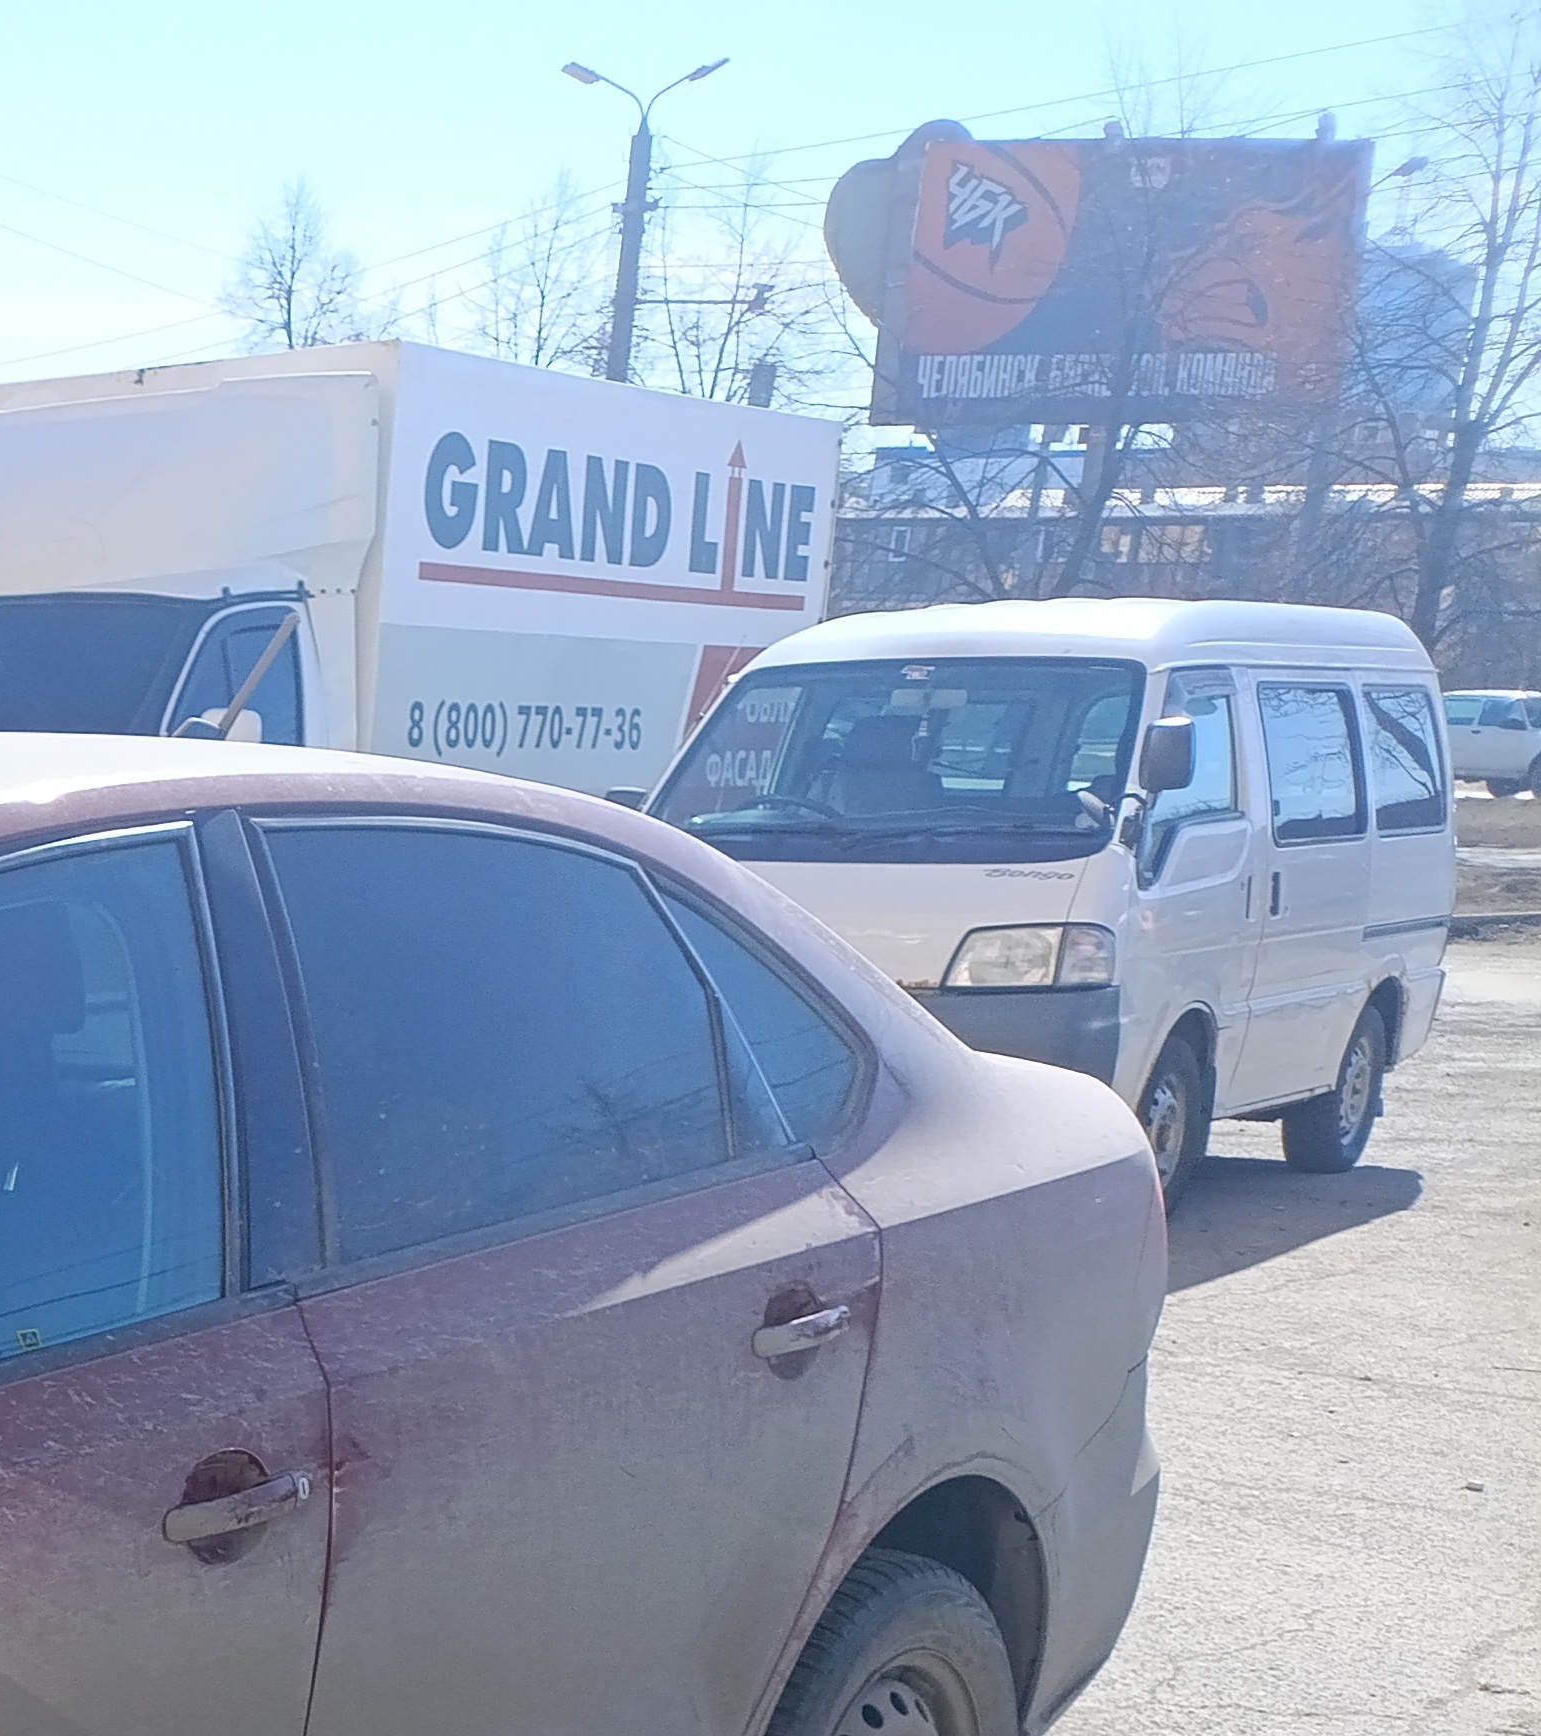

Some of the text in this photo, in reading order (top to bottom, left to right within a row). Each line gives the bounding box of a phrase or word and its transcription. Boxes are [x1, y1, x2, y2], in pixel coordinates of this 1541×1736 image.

[424, 431, 816, 583] GRAND LINE
[407, 699, 643, 757] 8 (800) 770-77-36
[983, 867, 1075, 881] Bongo
